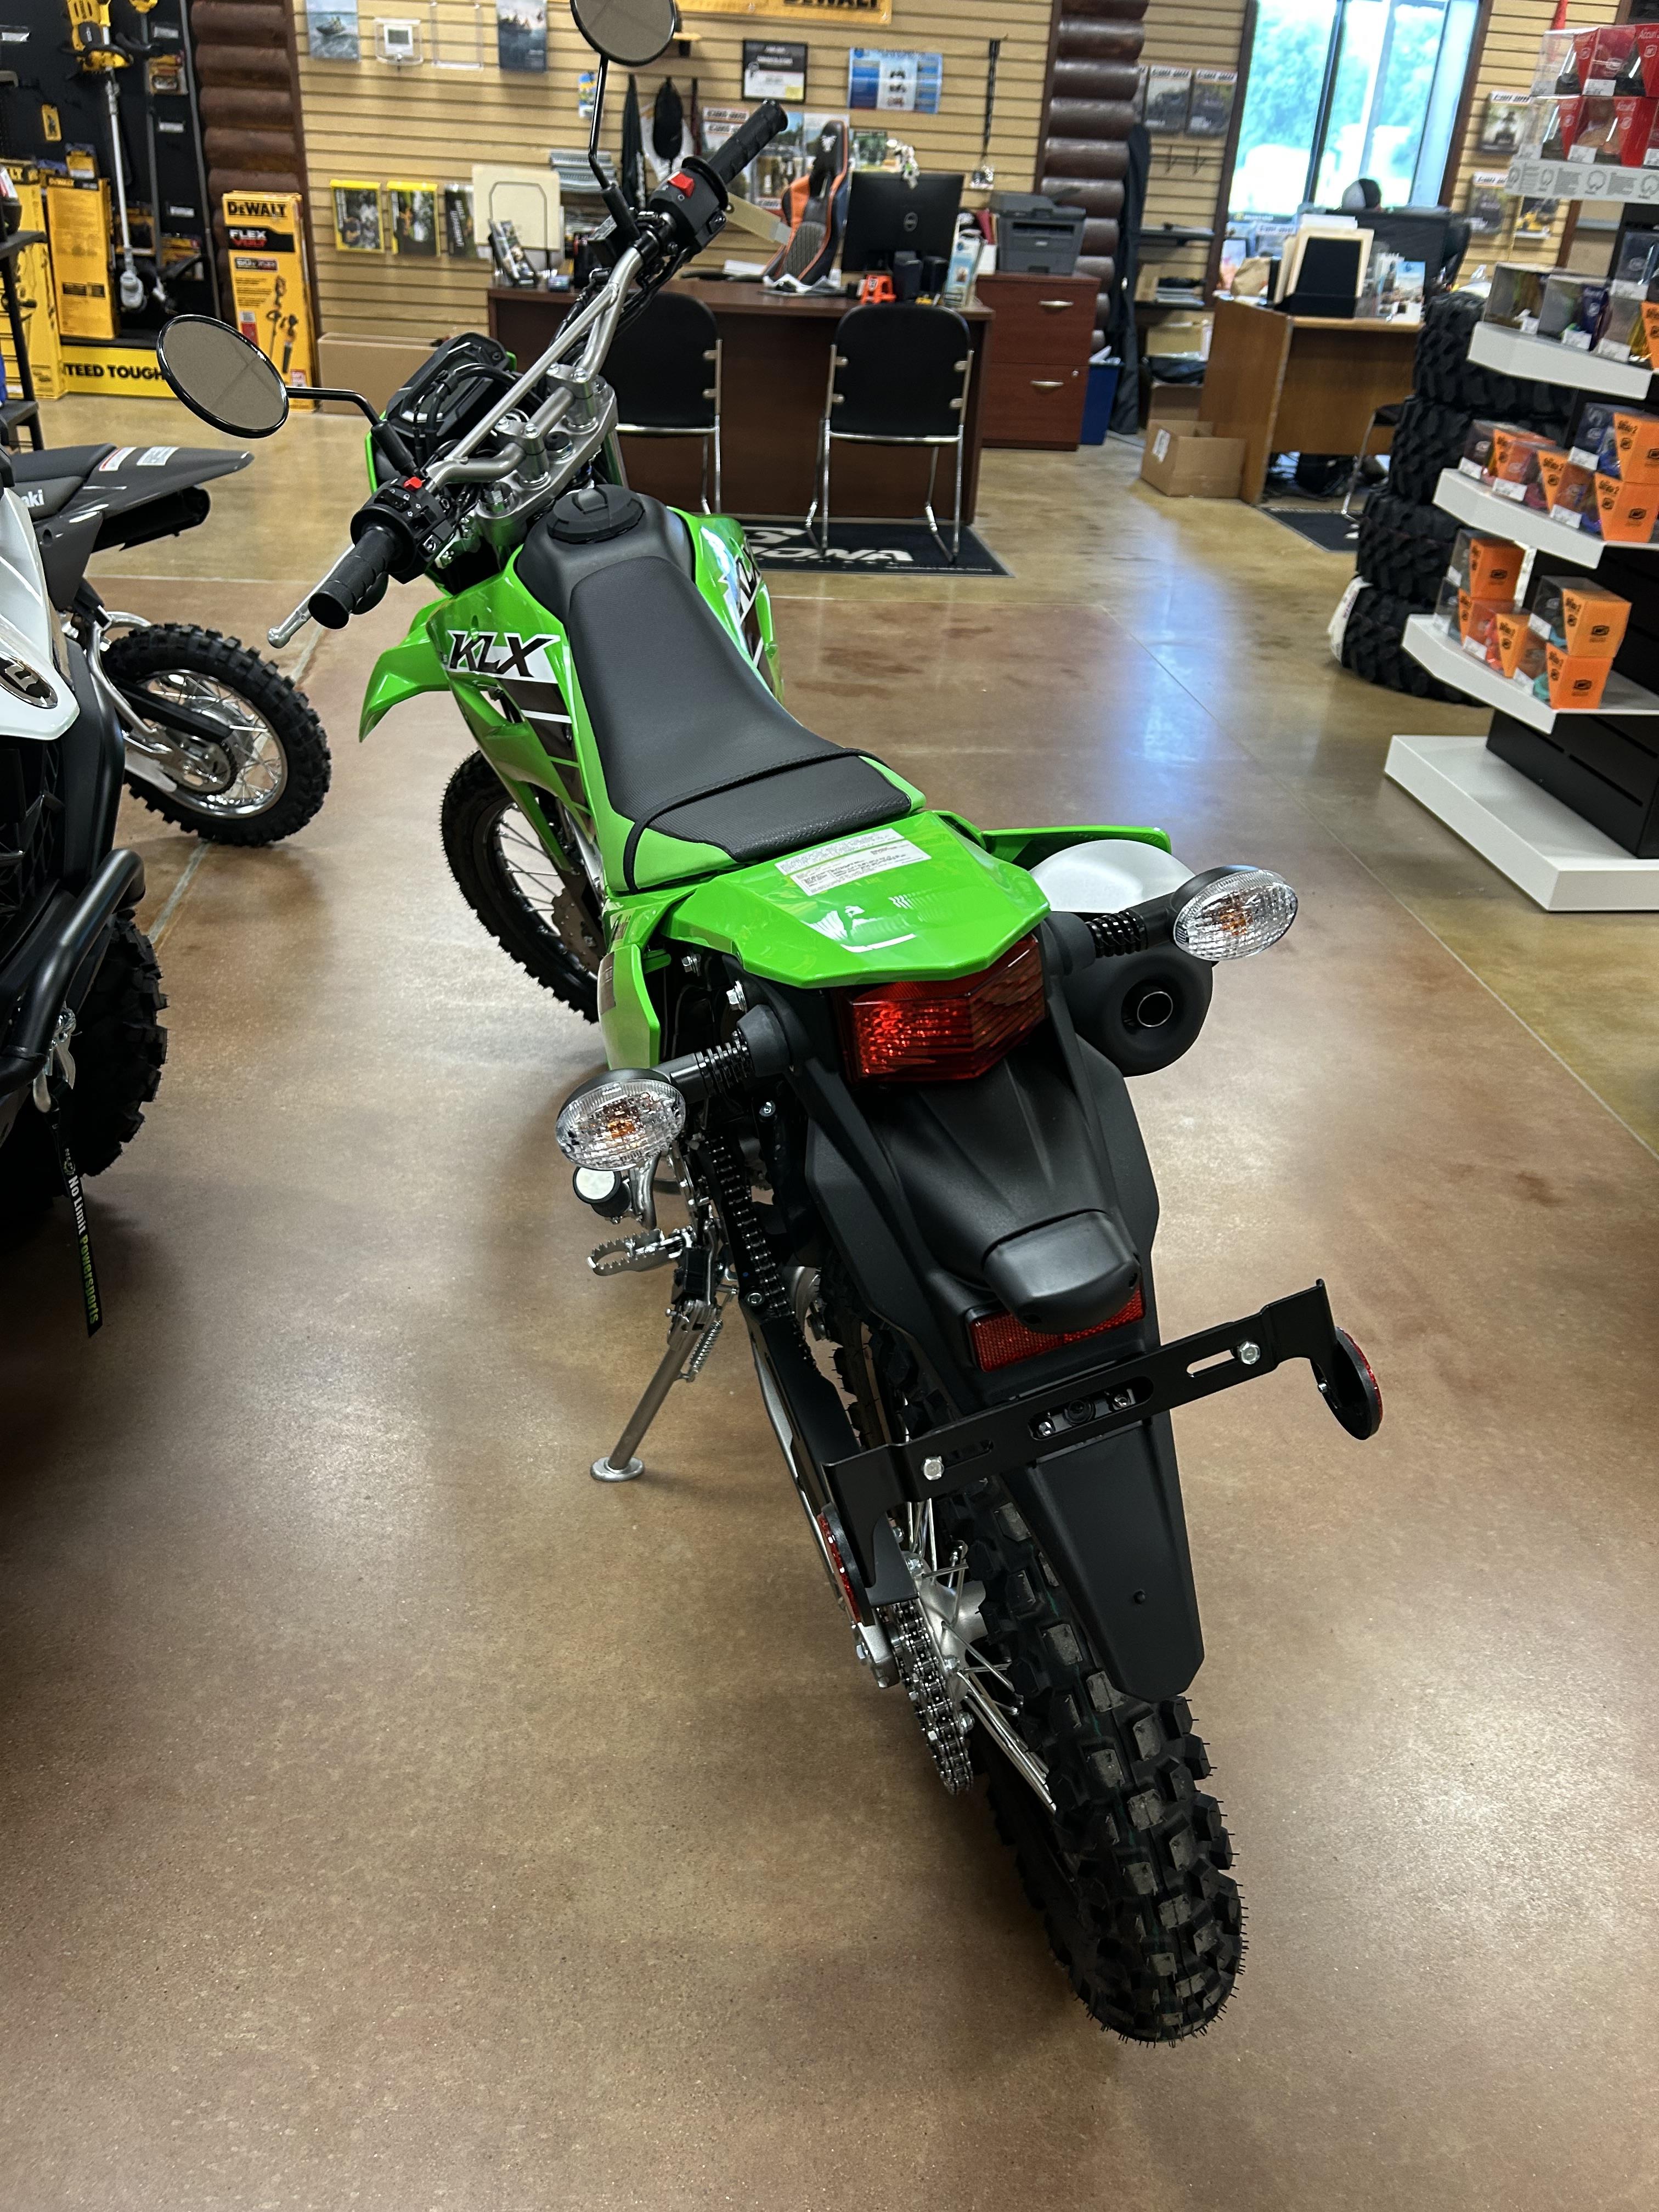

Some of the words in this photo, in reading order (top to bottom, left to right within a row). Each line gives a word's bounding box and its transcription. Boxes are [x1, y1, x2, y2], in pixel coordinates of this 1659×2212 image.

[229, 229, 267, 238] FLEX
[63, 363, 104, 377] TEED
[107, 364, 166, 380] TOUGH
[21, 489, 44, 507] aki
[448, 631, 558, 679] KLX
[68, 1175, 80, 1197] No
[74, 1195, 87, 1235] Limit
[79, 1234, 99, 1324] Powersports
